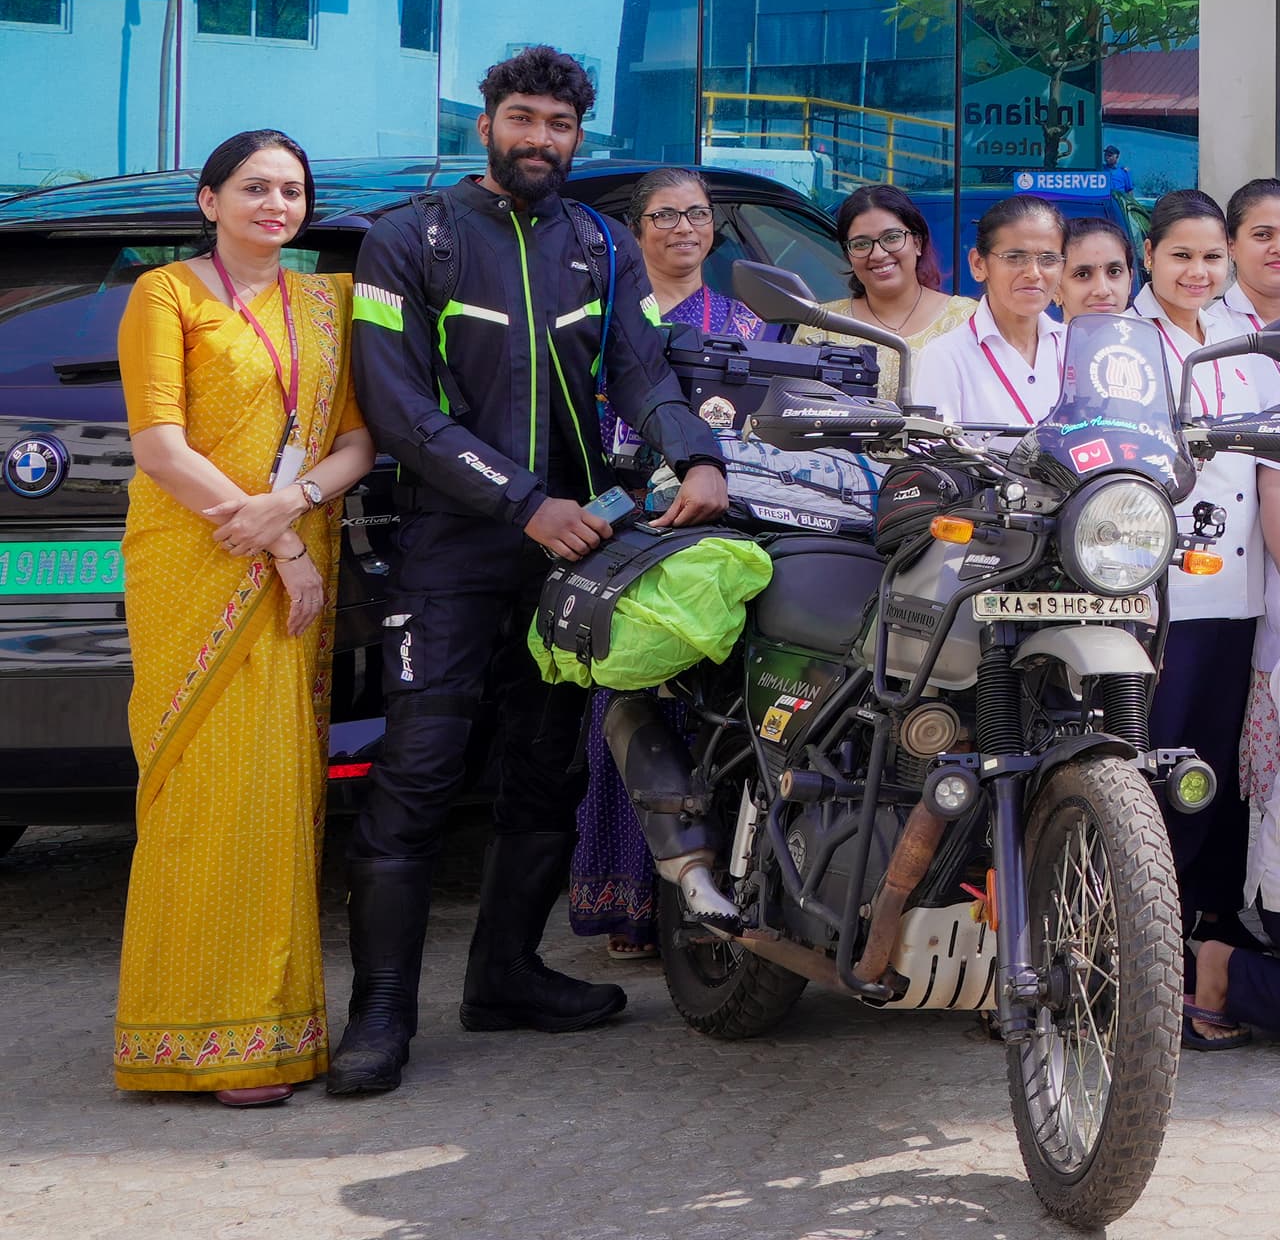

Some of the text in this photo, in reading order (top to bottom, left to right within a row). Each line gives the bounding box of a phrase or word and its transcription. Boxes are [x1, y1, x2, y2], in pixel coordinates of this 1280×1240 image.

[1037, 174, 1107, 190] RESERVED
[782, 408, 850, 418] Barkbusters
[12, 442, 54, 461] BMW
[458, 450, 509, 486] Raida
[758, 506, 833, 530] FRESH BLACK
[0, 549, 126, 586] 19MN83
[999, 597, 1145, 615] KA 19 HG 2400
[757, 671, 821, 700] HIMALAYAN
